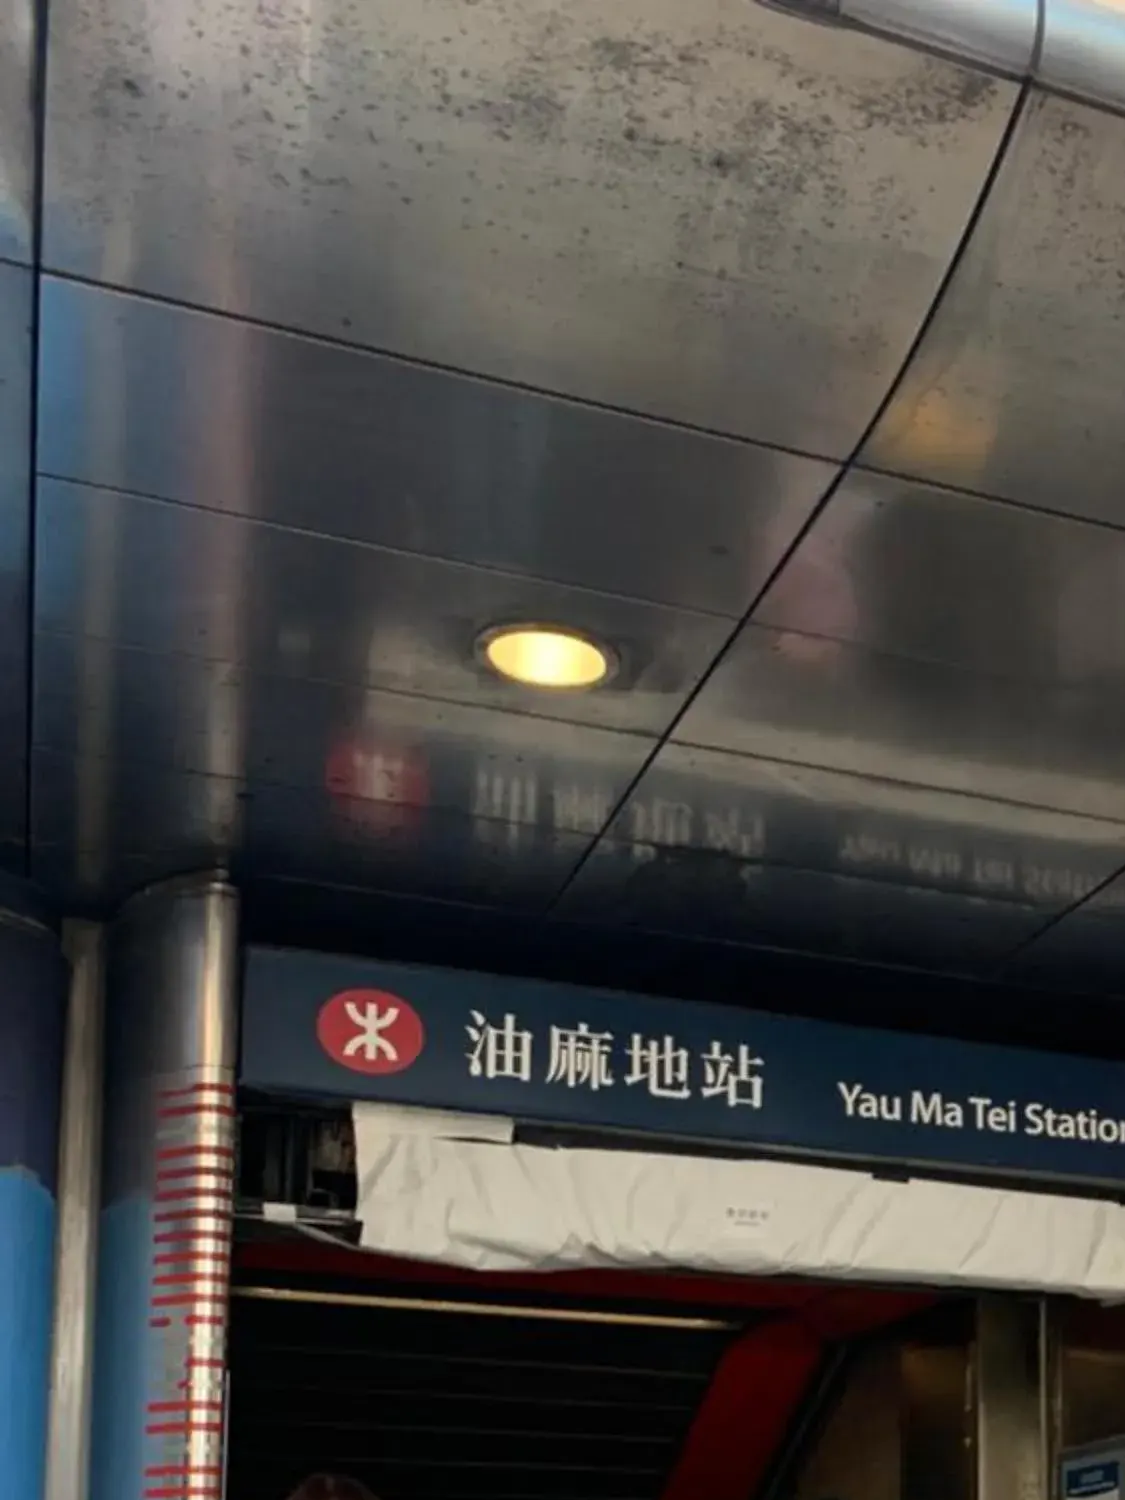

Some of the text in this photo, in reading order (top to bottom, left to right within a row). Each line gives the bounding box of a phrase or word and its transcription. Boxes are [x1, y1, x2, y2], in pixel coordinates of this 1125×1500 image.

[464, 1009, 766, 1109] 油麻地站
[837, 1082, 901, 1121] Yau
[910, 1091, 963, 1127] Ma
[969, 1097, 1016, 1133] Tei
